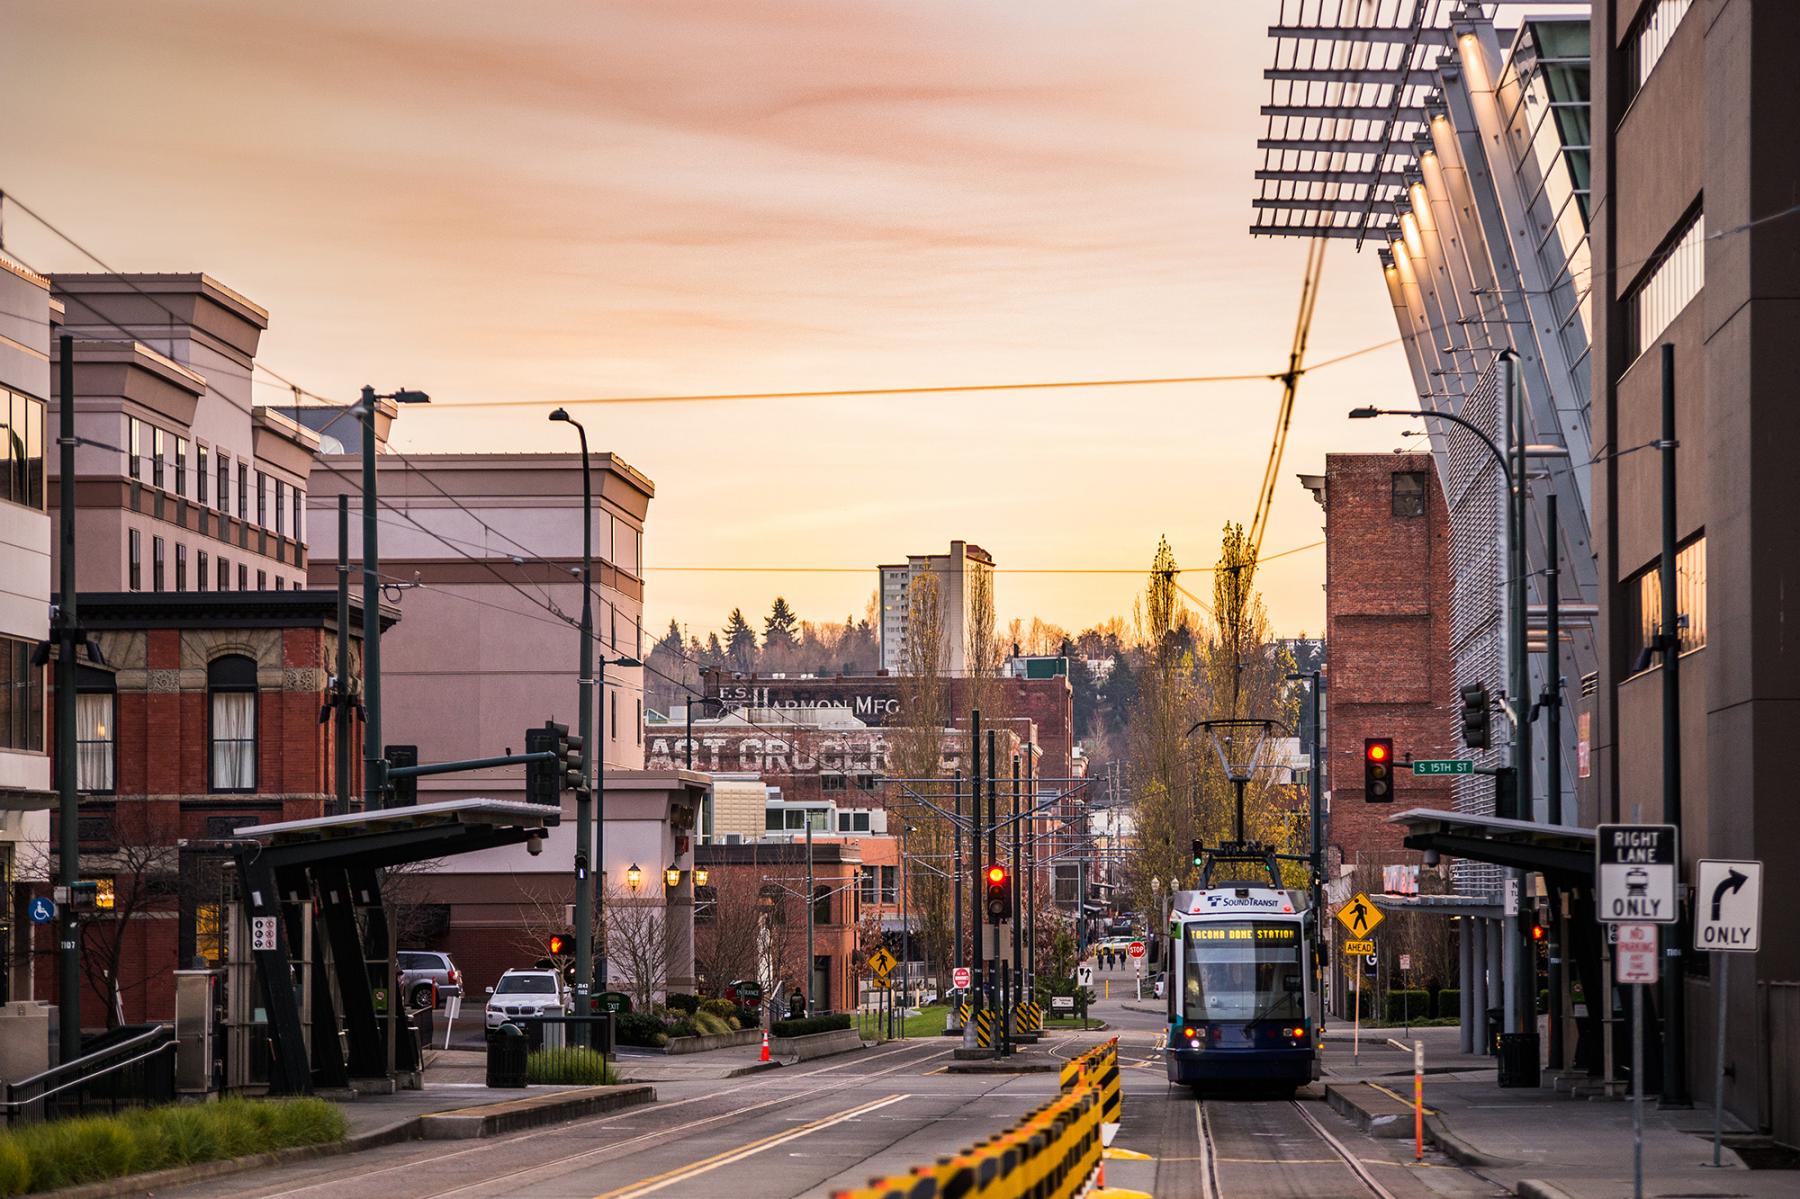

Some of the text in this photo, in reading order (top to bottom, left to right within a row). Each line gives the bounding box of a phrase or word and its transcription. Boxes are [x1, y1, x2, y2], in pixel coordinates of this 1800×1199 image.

[1419, 762, 1468, 772] S 15TH ST
[1614, 832, 1659, 847] RIGHT
[1617, 849, 1656, 862] LANE
[1613, 898, 1661, 916] ONLY
[1191, 930, 1294, 939] TACOMA DOME STATION
[1704, 926, 1751, 944] ONLY
[1129, 945, 1144, 954] STOP
[1347, 943, 1372, 952] AHEAD
[607, 1002, 620, 1010] EXIT
